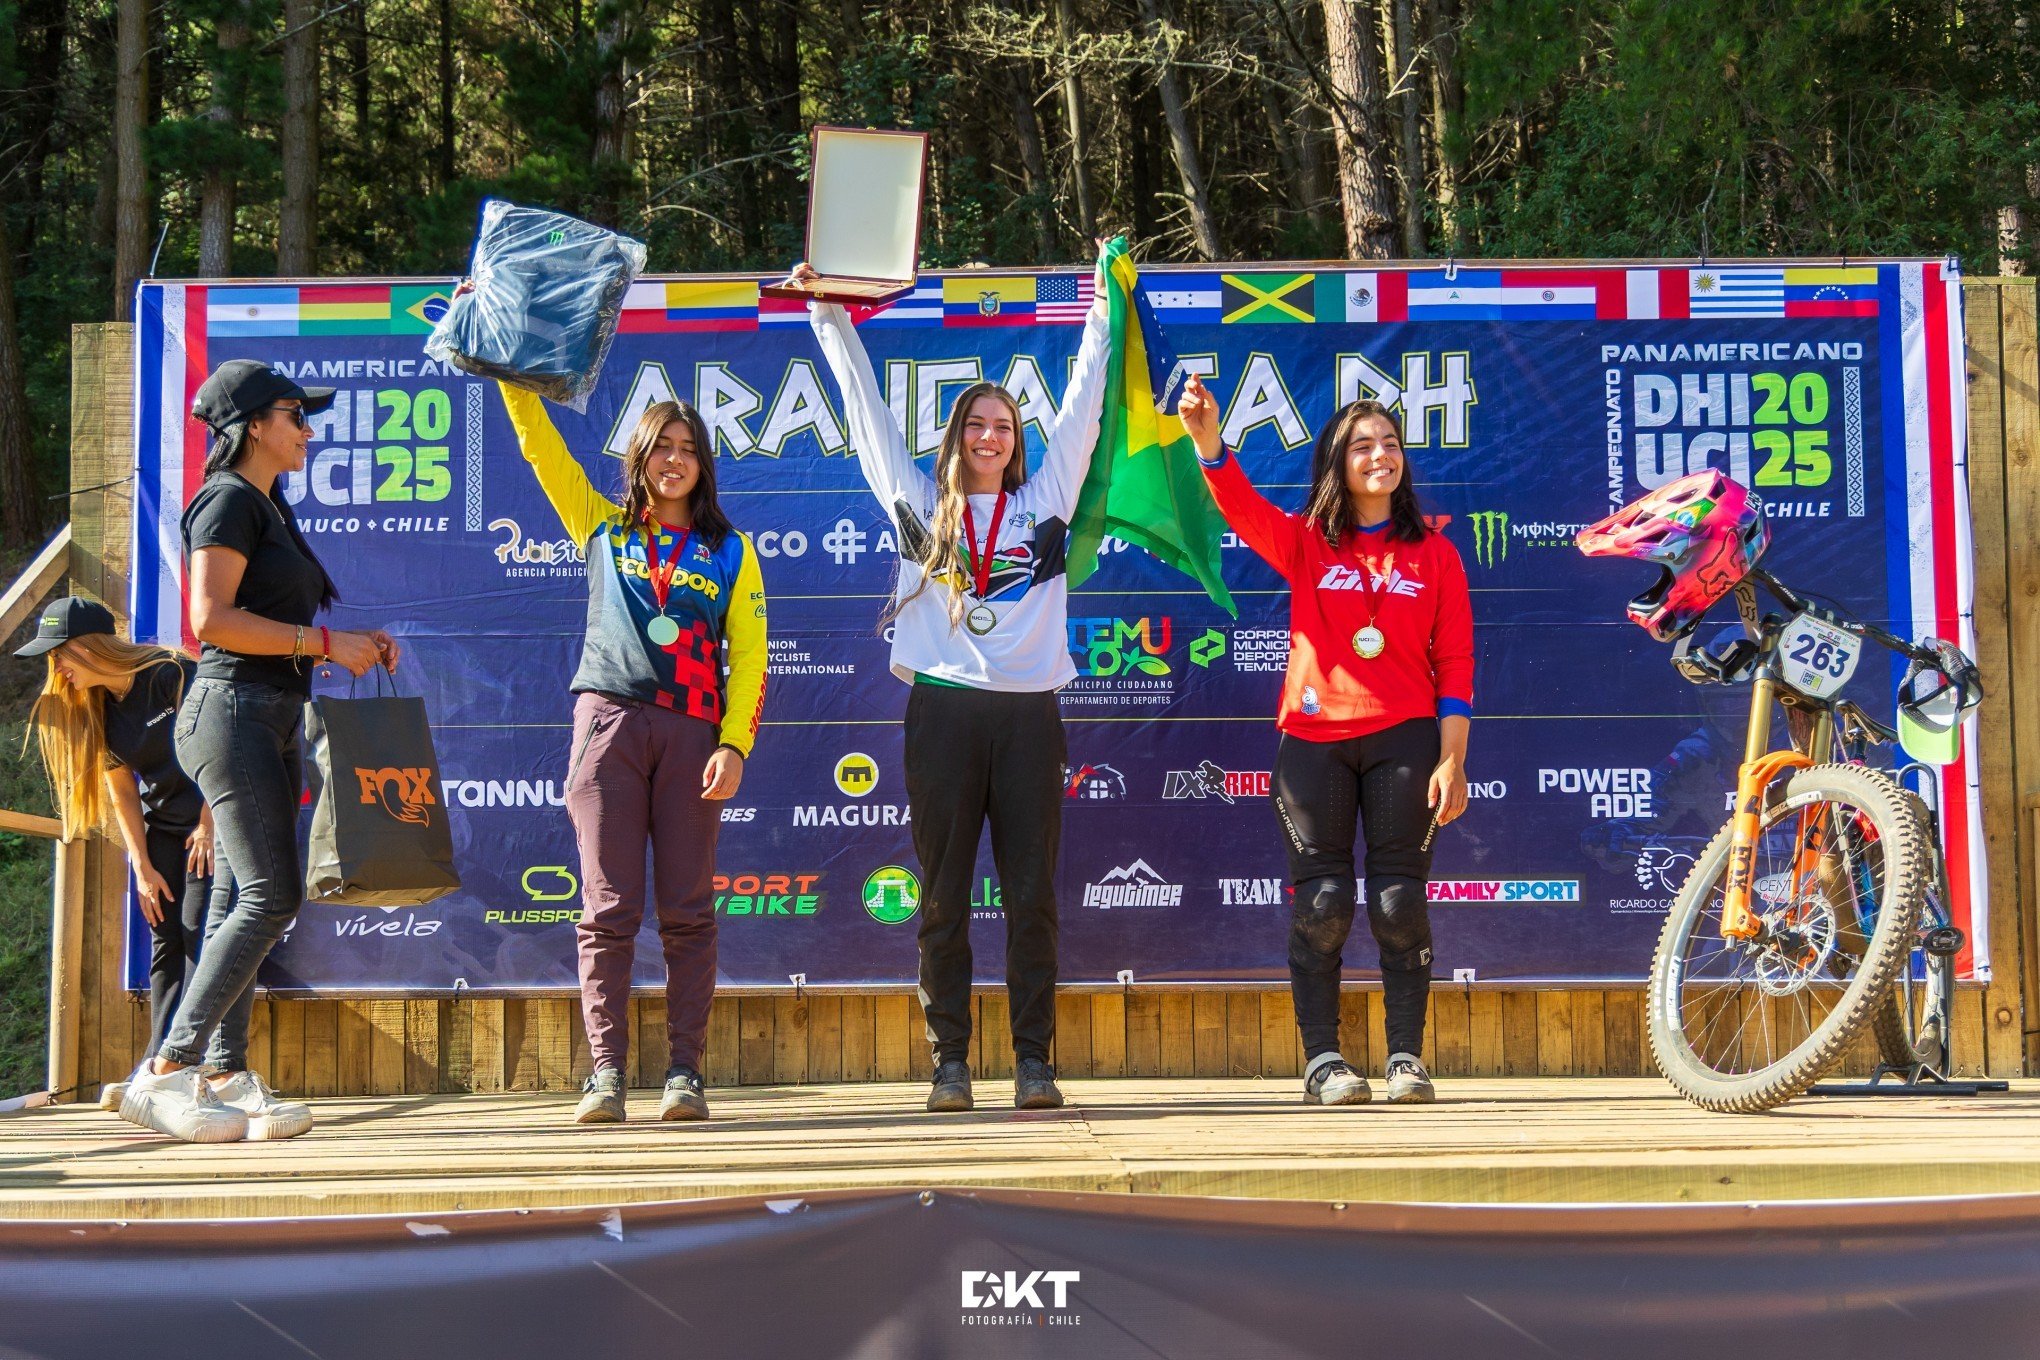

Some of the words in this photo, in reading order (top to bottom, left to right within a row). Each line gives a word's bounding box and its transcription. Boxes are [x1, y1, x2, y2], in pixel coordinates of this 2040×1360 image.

[1601, 342, 1863, 362] PANAMERICANO
[274, 360, 476, 378] NAMERICAN
[1336, 351, 1478, 448] DH
[1764, 502, 1831, 518] CHILE
[383, 517, 449, 532] CHILE
[745, 531, 808, 558] CO
[693, 554, 713, 565] FEC
[506, 568, 546, 577] AGENCIA
[550, 567, 587, 576] PUBLICI
[615, 555, 720, 601] ECUDOR
[1317, 561, 1426, 598] CLE
[768, 640, 797, 650] NION
[1789, 633, 1851, 678] 263
[768, 653, 811, 662] YCLISTE
[1117, 680, 1173, 689] CIUDADANO
[1060, 696, 1119, 705] DEPARTAMENTO
[1121, 696, 1131, 705] DE
[1133, 696, 1171, 705] DEPORTES
[354, 767, 436, 815] FOX
[1538, 768, 1652, 793] POWER
[792, 805, 912, 827] MAGURA
[1591, 793, 1653, 818] ADE
[1420, 800, 1443, 852] COMME
[1218, 878, 1283, 906] TEAM
[1427, 882, 1500, 901] FAMILY
[1503, 881, 1577, 900] SPORT
[1609, 898, 1657, 909] RICARDO
[335, 912, 443, 937] vívela
